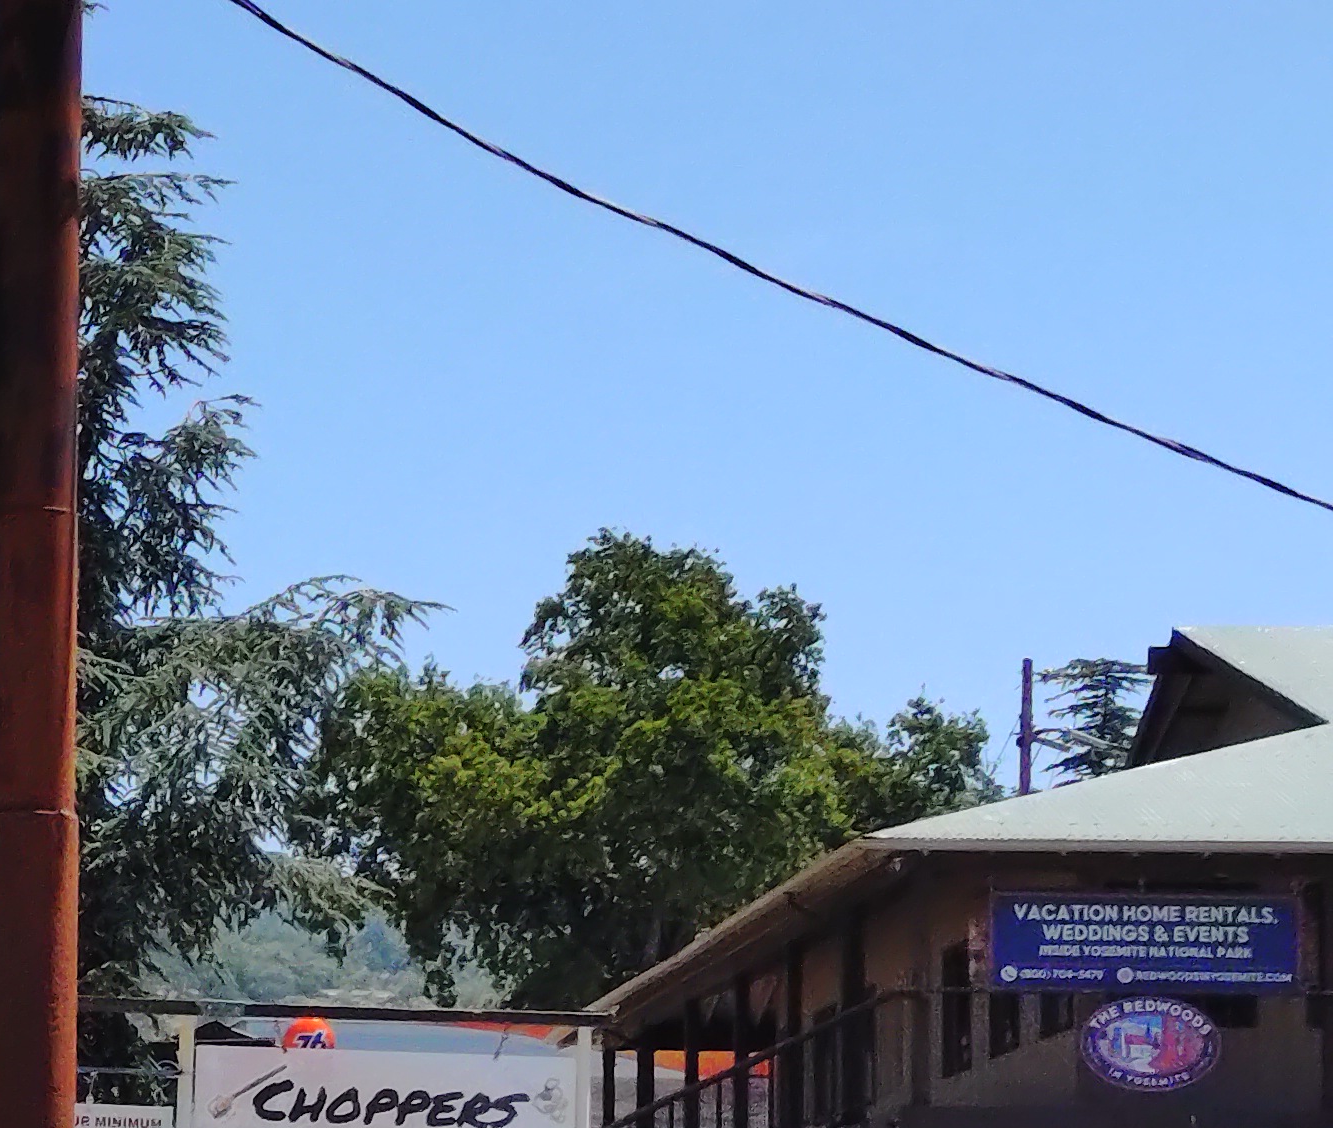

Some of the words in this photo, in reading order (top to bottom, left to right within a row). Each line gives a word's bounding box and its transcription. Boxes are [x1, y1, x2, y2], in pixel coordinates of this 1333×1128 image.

[1013, 903, 1119, 922] VACATION
[1123, 905, 1182, 923] HOME
[1042, 924, 1150, 942] WEDDINGS
[1153, 925, 1170, 943] &
[1173, 925, 1250, 944] EVENTS
[1149, 945, 1215, 959] NATIONAL
[1216, 946, 1253, 960] PARK
[1089, 1005, 1120, 1029] THE
[1123, 1000, 1212, 1035] REDWOODS
[94, 1116, 162, 1128] MINIMUM
